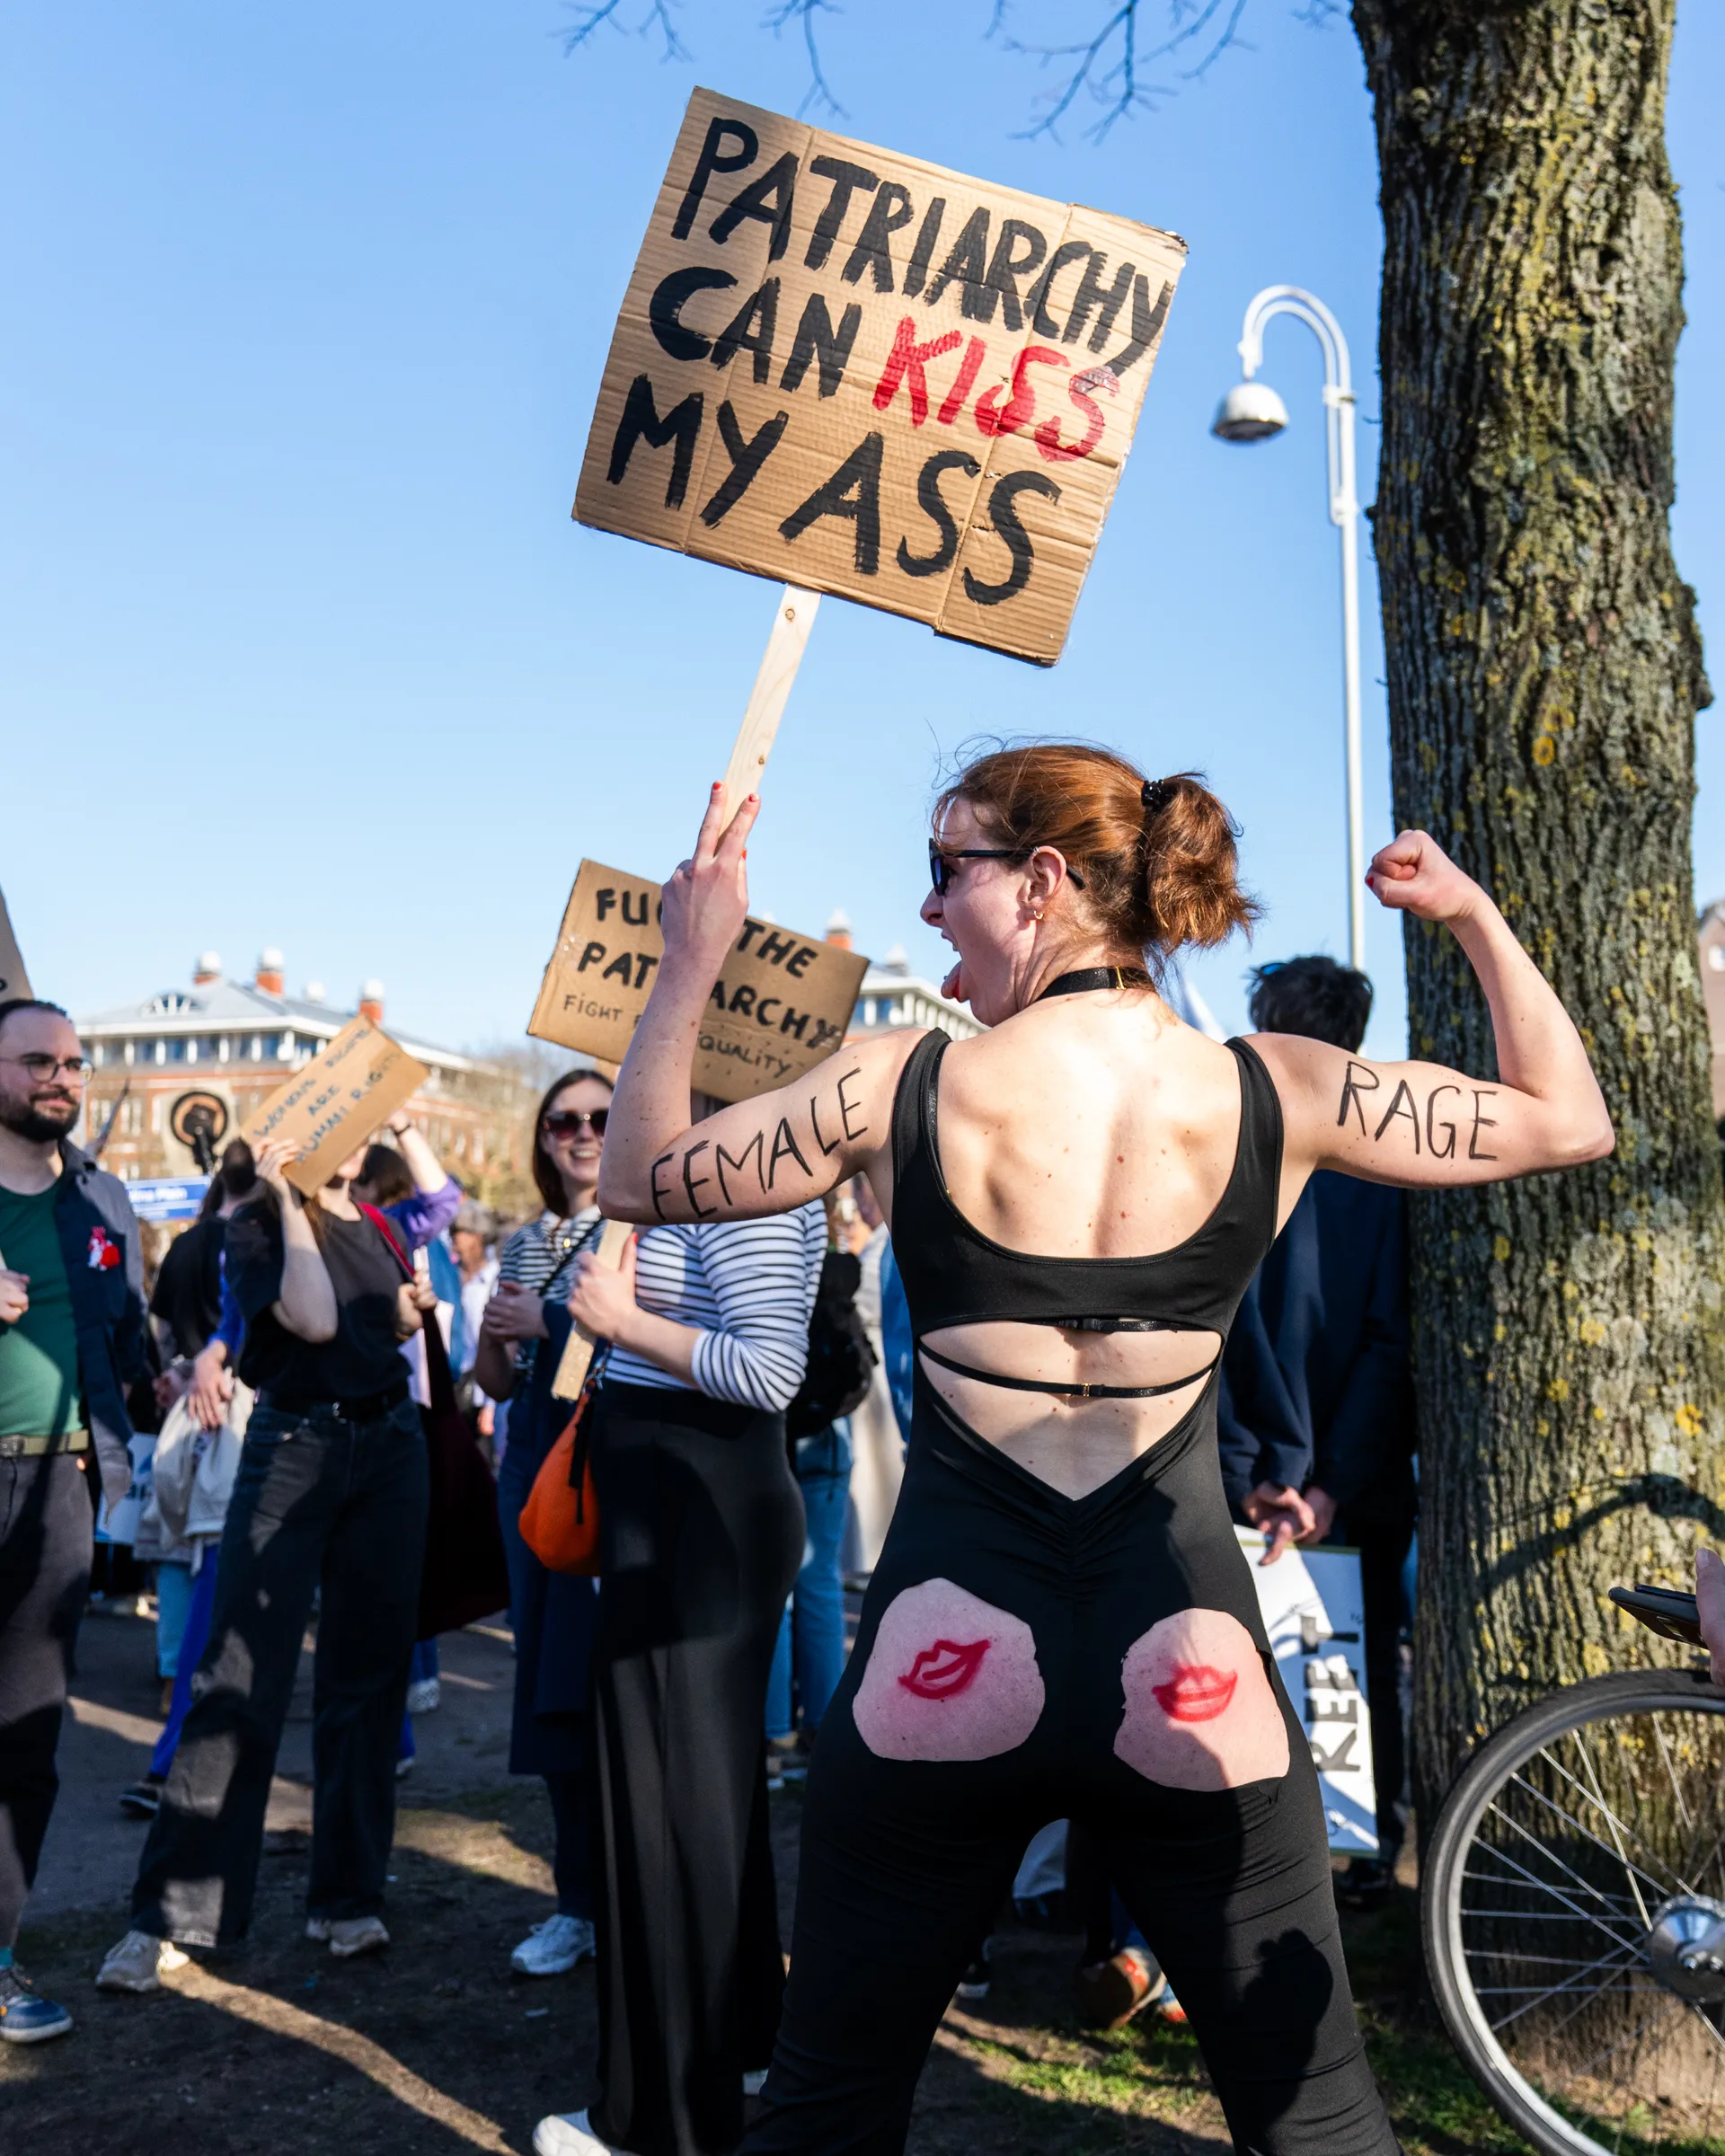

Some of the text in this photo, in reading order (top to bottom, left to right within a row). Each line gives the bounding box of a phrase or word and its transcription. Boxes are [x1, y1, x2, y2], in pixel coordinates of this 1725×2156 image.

[670, 117, 1173, 379] PATRIARCHY
[649, 266, 1119, 462] CAN KISS
[606, 373, 1063, 605] MY ASS
[577, 941, 841, 1049] PATARCHY
[735, 918, 819, 979] THE
[650, 1067, 868, 1222] FEMALE
[1336, 1060, 1500, 1161] RAGE
